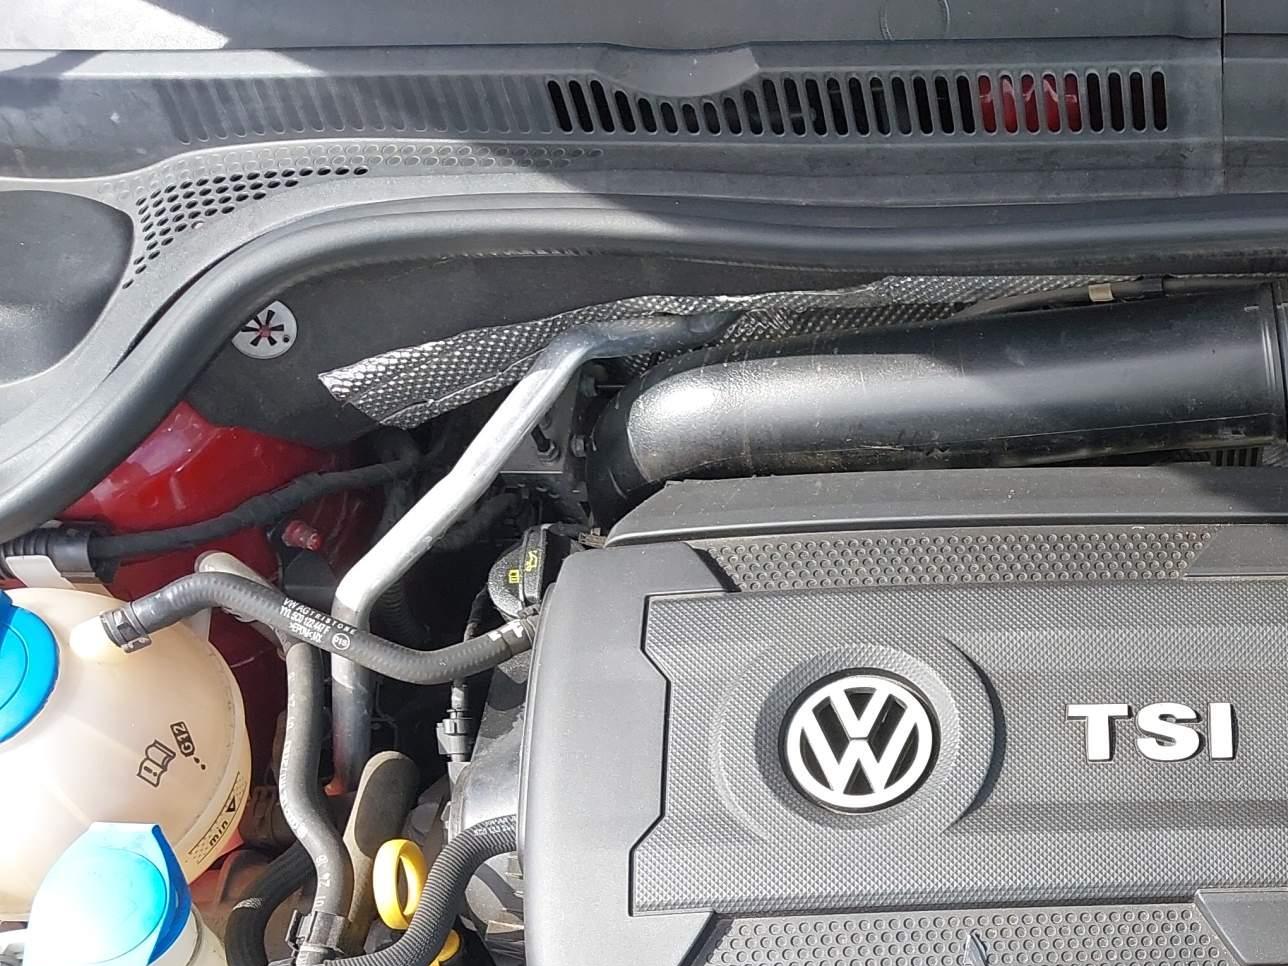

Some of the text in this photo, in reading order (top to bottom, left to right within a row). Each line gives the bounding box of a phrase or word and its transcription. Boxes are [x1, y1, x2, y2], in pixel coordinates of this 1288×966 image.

[173, 724, 192, 752] G12
[1066, 701, 1237, 763] TSI
[208, 819, 229, 847] min
